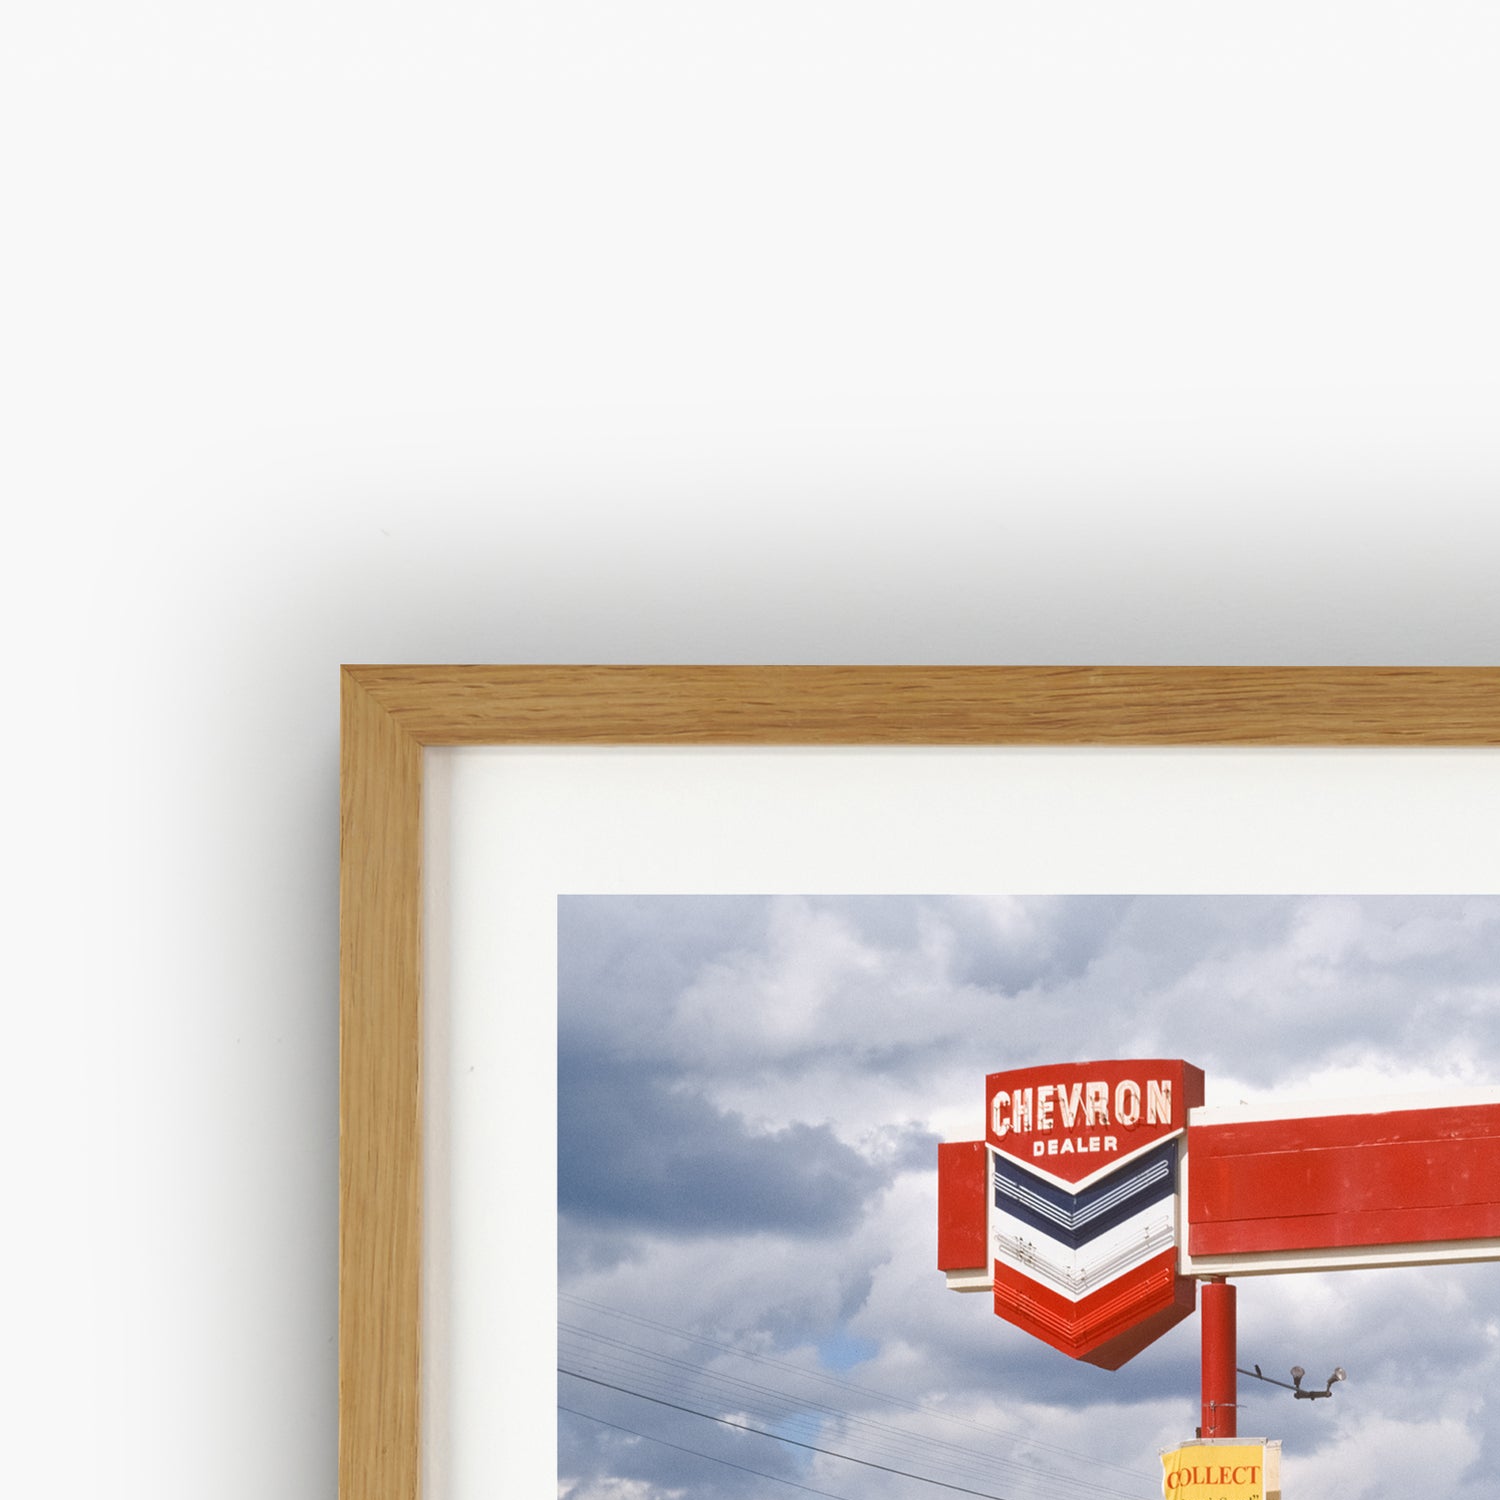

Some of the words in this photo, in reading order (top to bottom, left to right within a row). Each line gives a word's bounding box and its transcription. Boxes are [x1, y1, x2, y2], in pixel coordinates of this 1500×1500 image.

[991, 1079, 1172, 1137] CHEVRON
[1033, 1136, 1118, 1157] DEALER
[1167, 1465, 1260, 1489] COLLECT
